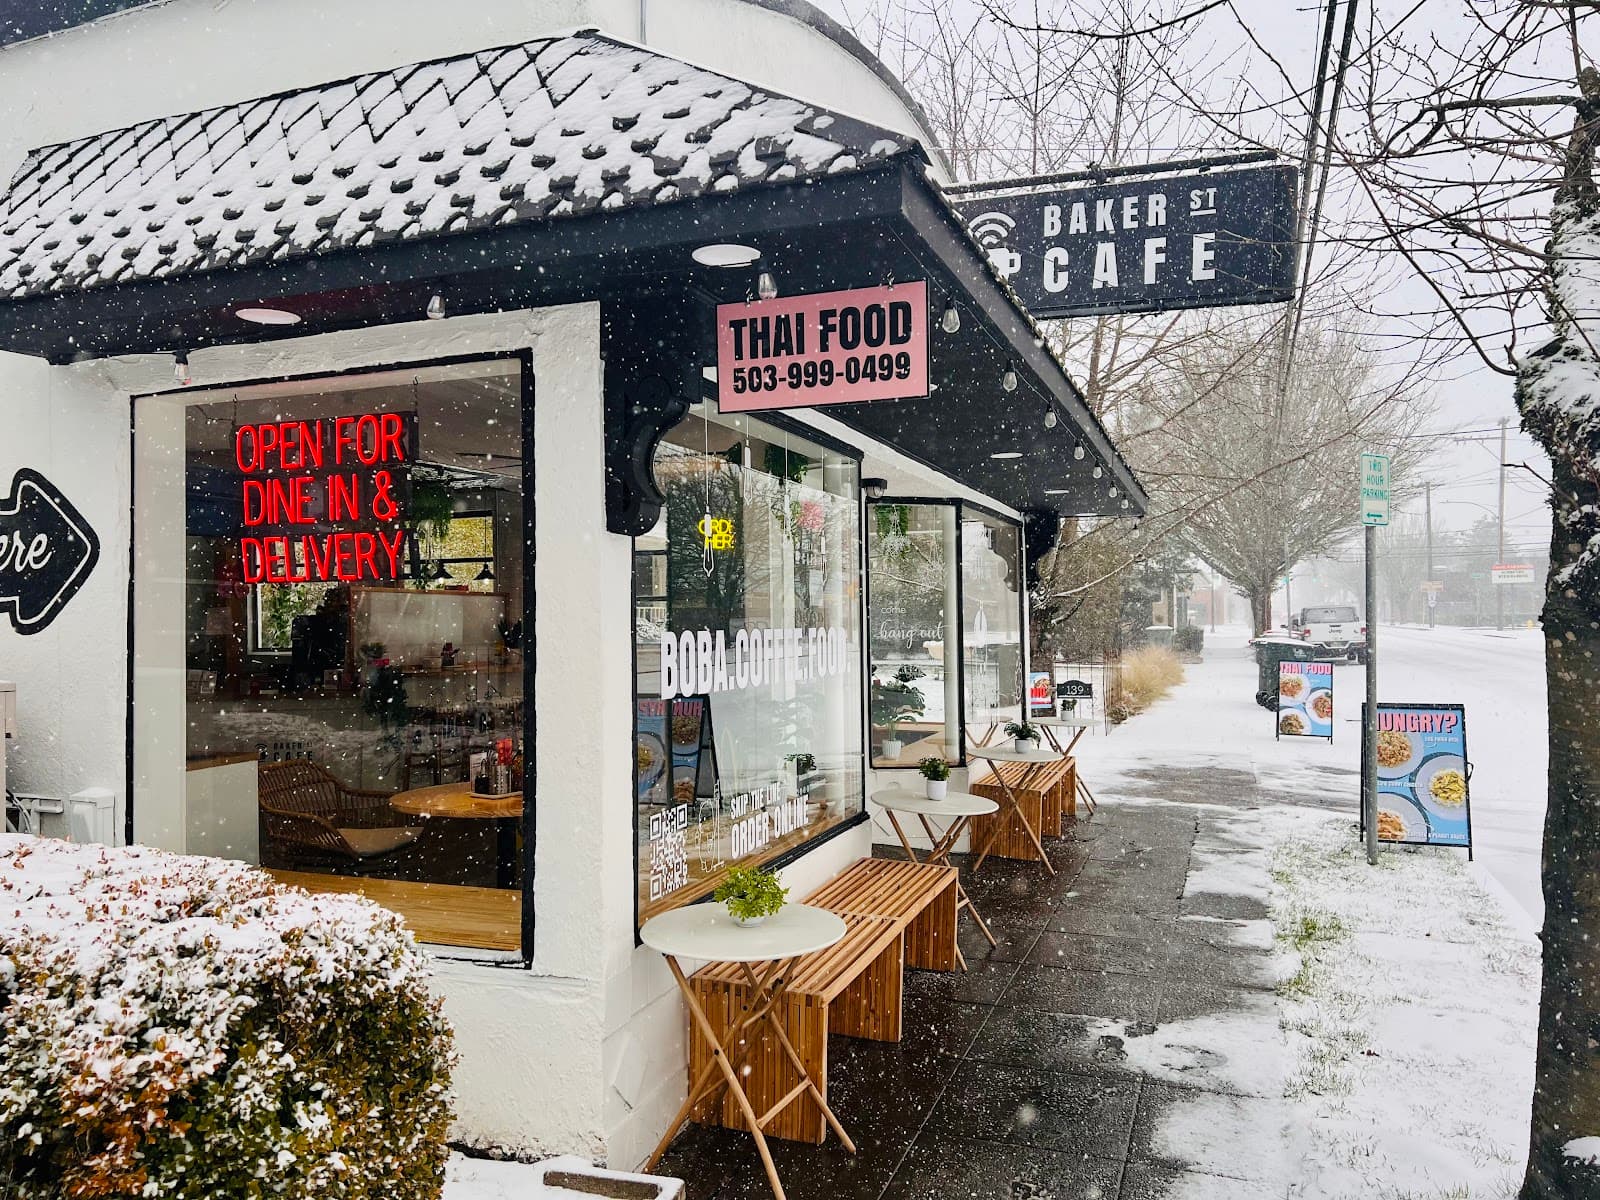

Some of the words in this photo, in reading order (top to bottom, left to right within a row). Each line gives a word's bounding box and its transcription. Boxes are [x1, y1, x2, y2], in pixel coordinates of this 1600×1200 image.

[1043, 193, 1168, 237] BAKER
[1189, 187, 1217, 211] ST
[1043, 233, 1216, 293] CAFE
[729, 312, 805, 360] THAI
[819, 301, 912, 352] FOOD
[733, 351, 911, 394] 503-999-0499
[235, 421, 323, 474] OPEN
[335, 413, 404, 463] FOR
[1366, 475, 1384, 486] HOUR
[1369, 461, 1382, 473] TWO
[242, 475, 316, 526] DINE
[327, 472, 359, 521] IN
[373, 471, 398, 520] &
[1362, 487, 1388, 501] PARKING
[241, 530, 405, 583] DELIVERY
[880, 606, 906, 614] come
[874, 619, 915, 649] hang
[918, 621, 951, 639] out
[1280, 663, 1303, 674] THAI
[1305, 663, 1332, 675] FOOD
[1066, 685, 1084, 695] 139
[731, 794, 749, 820] SKIP
[751, 788, 764, 811] THE
[732, 811, 769, 859] ORDER
[774, 794, 809, 838] ONLINE
